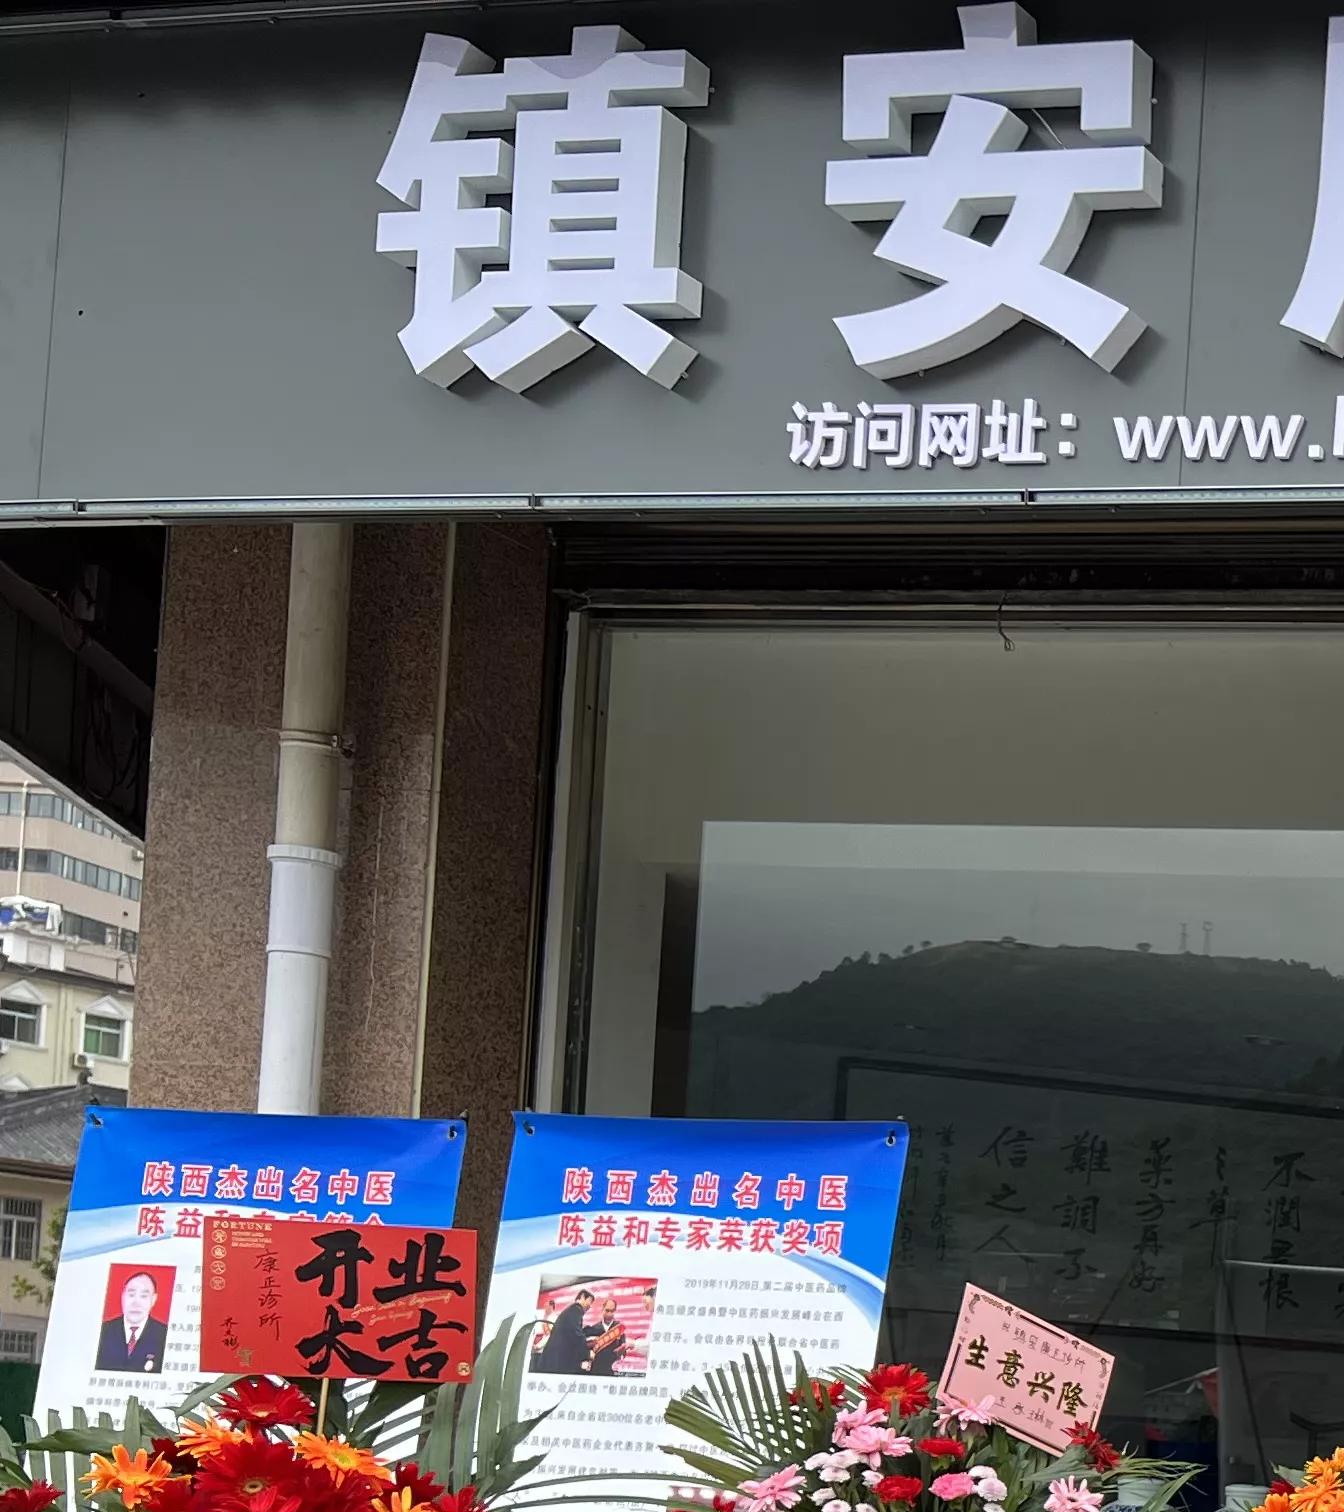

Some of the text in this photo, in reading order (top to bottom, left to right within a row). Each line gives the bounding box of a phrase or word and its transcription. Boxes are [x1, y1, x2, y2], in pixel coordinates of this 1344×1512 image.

[141, 1160, 396, 1206] 陕西杰出名中医
[562, 1166, 849, 1212] 陕西杰出名中医
[557, 1212, 845, 1257] 陈益和专家荣获奖项
[295, 1229, 468, 1308] 开业
[295, 1304, 469, 1379] 大吉
[964, 1334, 1088, 1418] 生意兴隆
